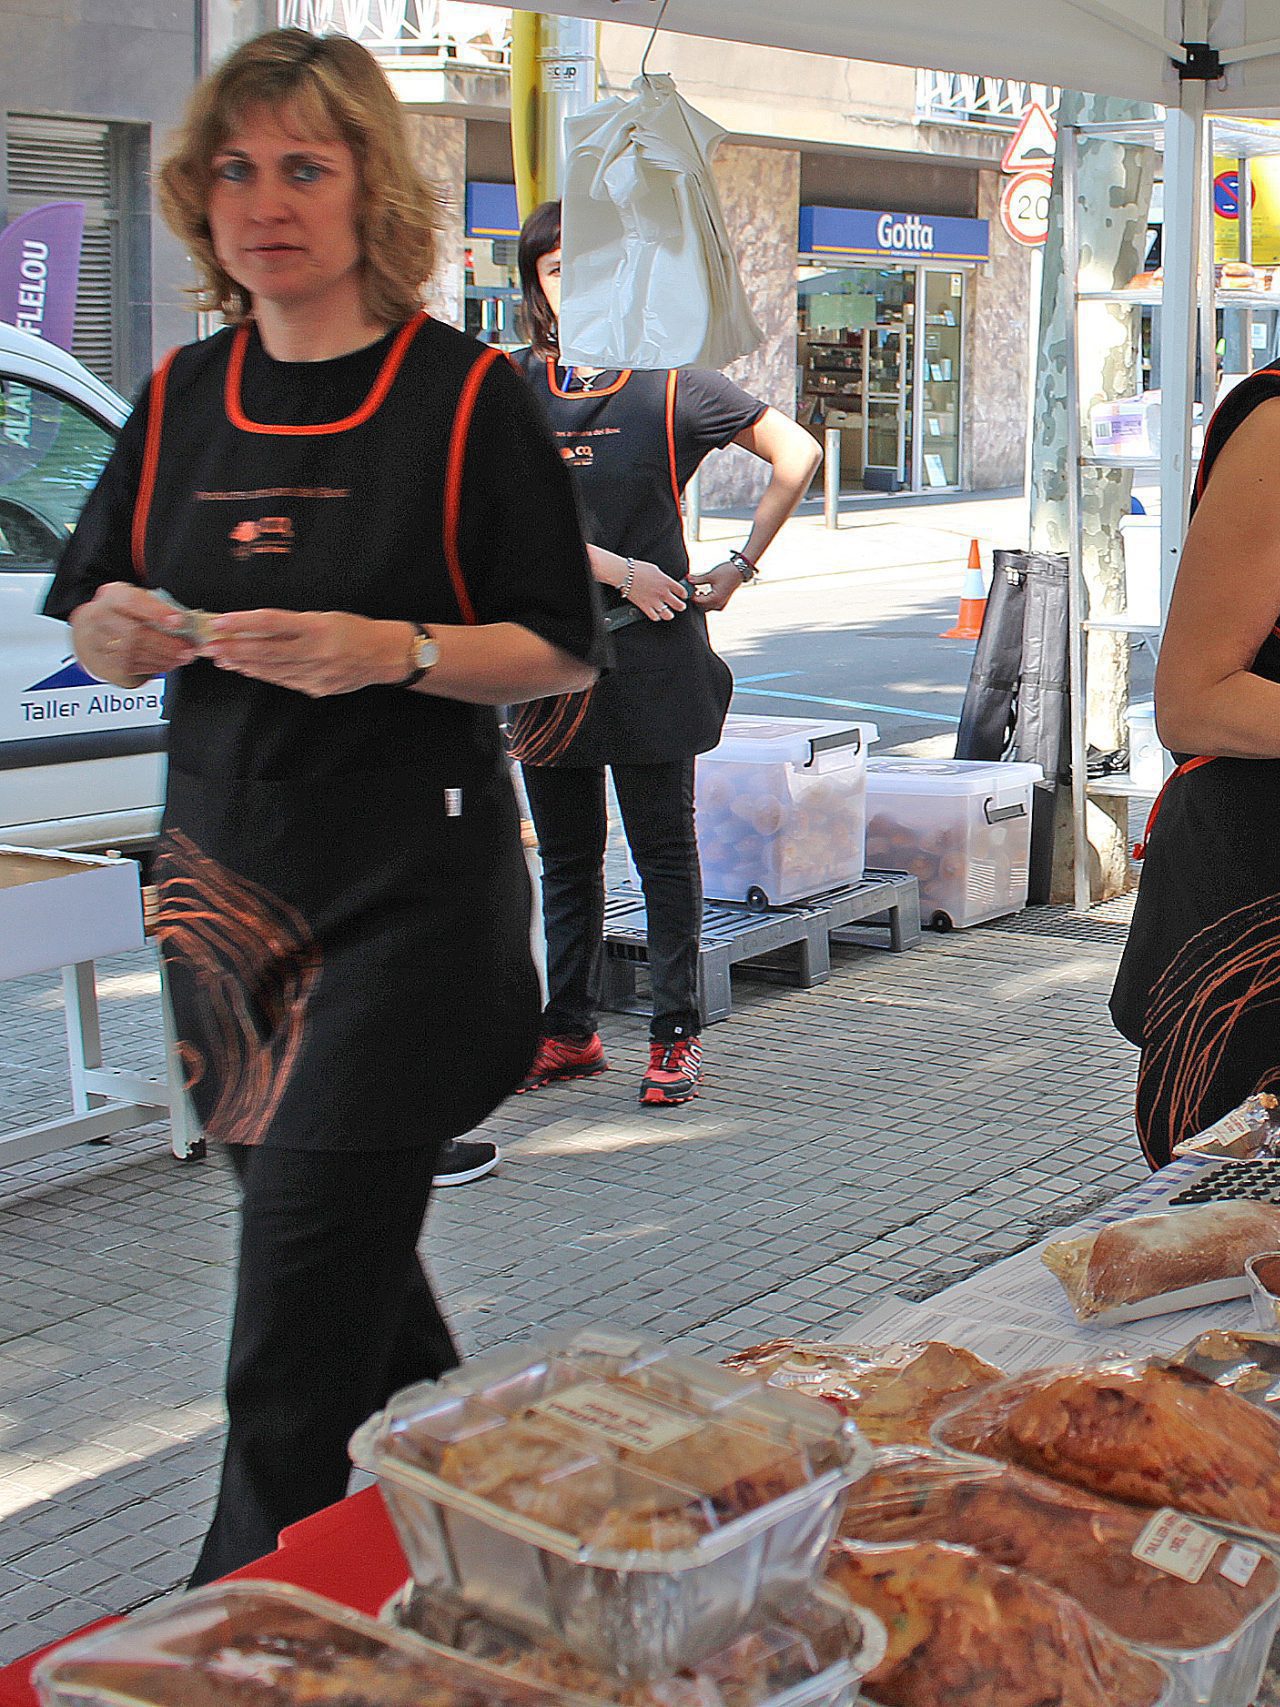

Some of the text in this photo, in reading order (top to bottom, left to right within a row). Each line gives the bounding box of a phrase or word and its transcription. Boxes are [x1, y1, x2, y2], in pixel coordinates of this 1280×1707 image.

[1018, 195, 1050, 220] 20
[877, 213, 934, 250] Gotta
[20, 700, 80, 721] Taller
